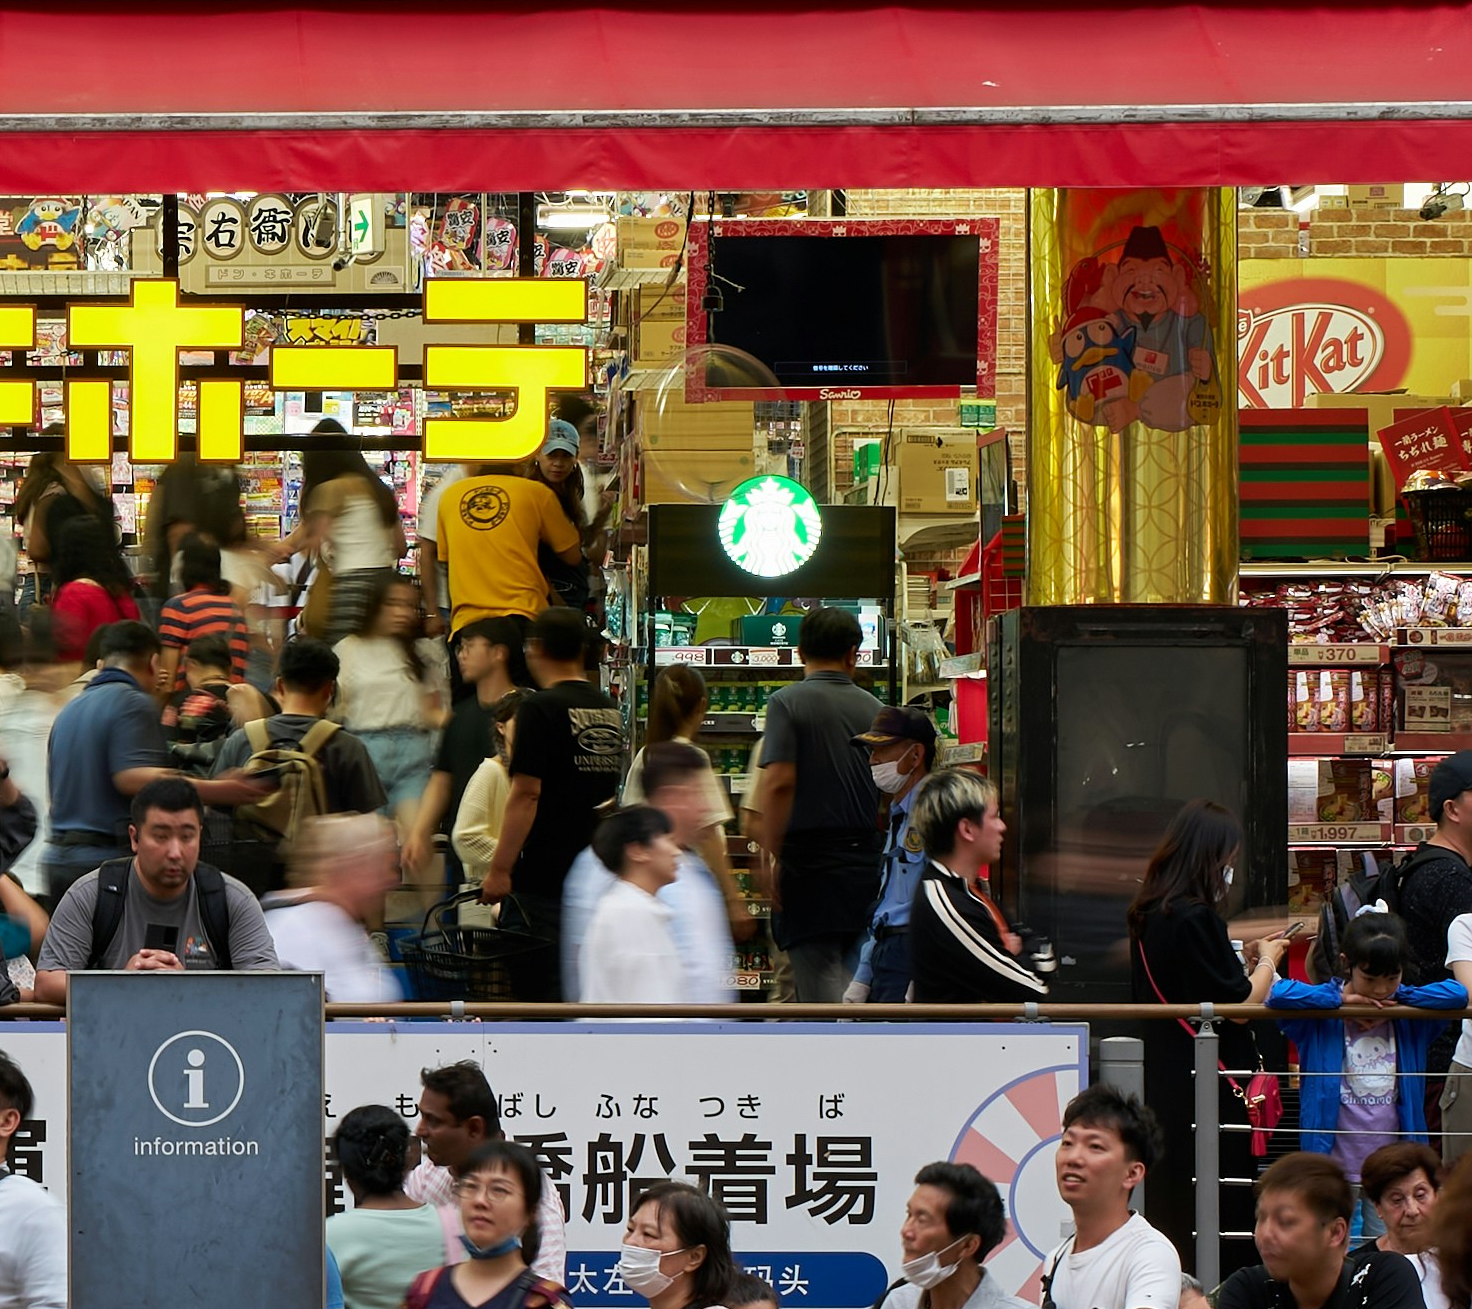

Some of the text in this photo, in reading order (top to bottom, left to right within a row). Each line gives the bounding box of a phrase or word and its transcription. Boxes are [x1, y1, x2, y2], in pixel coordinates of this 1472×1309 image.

[819, 388, 862, 400] Sanrio
[595, 1093, 659, 1119] ふな
[698, 1093, 763, 1119] つき
[820, 1092, 846, 1119] ば
[133, 1136, 259, 1156] information
